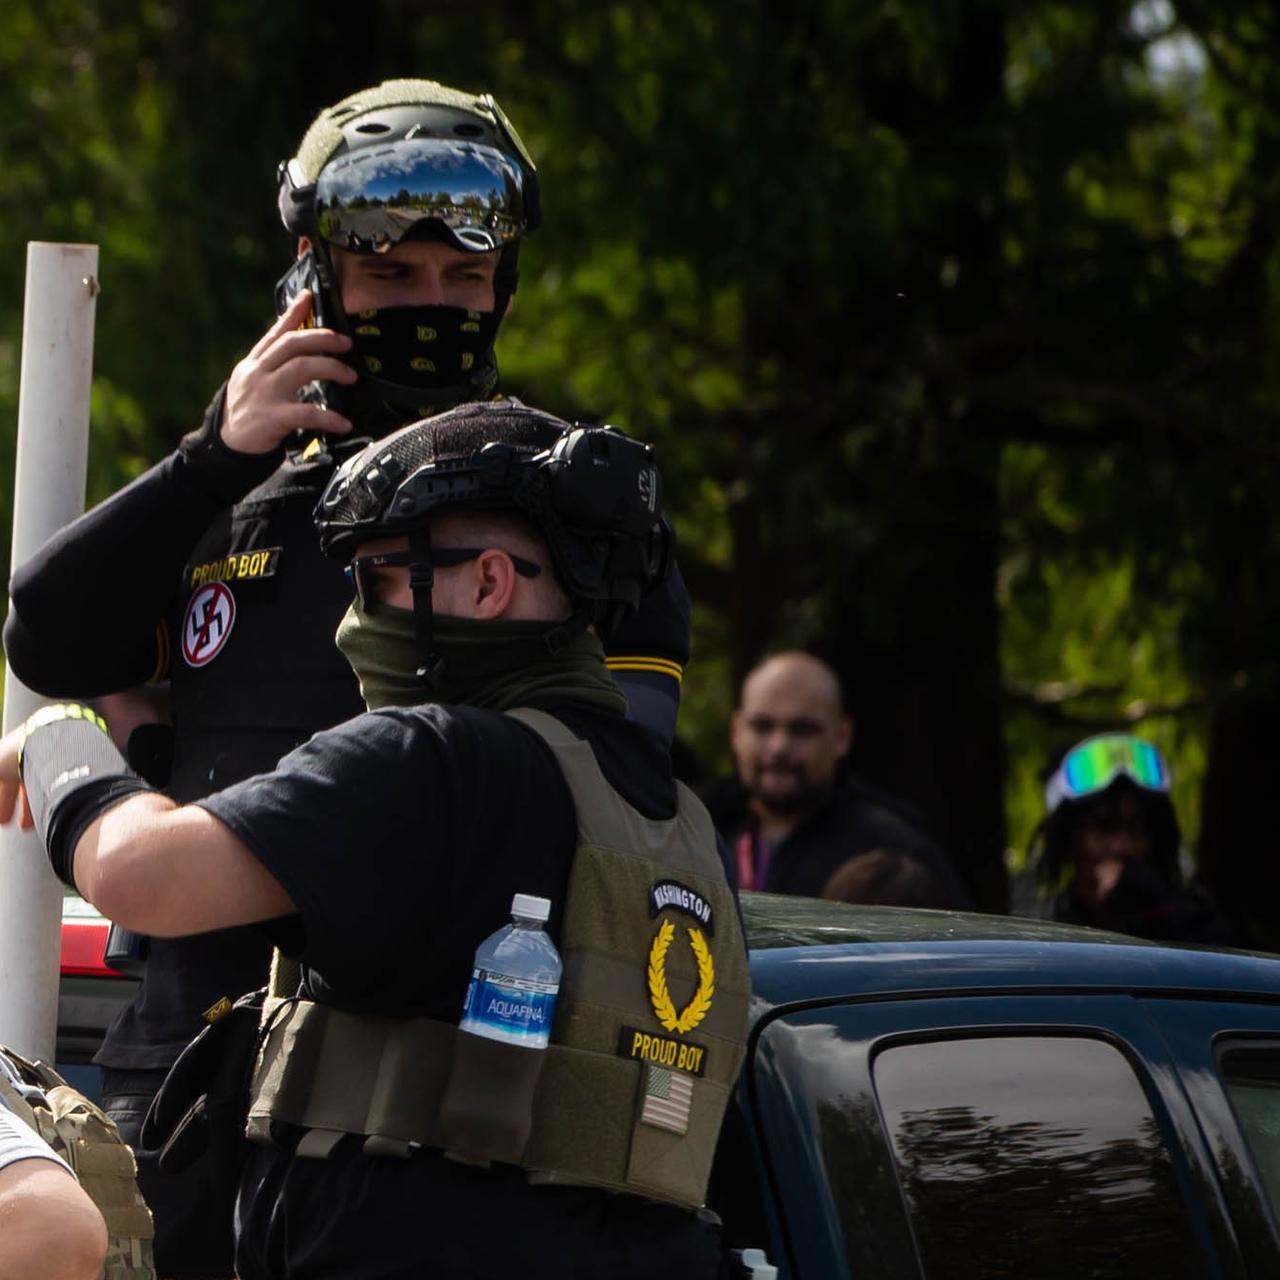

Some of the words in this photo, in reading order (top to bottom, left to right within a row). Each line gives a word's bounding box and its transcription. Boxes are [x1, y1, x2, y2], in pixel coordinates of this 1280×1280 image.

[191, 557, 236, 587] PROUD
[238, 551, 270, 578] BOY
[653, 885, 711, 922] WASHINGTON
[487, 998, 544, 1021] AQUAFINA
[632, 1032, 678, 1065] PROUD
[677, 1045, 704, 1073] BOY
